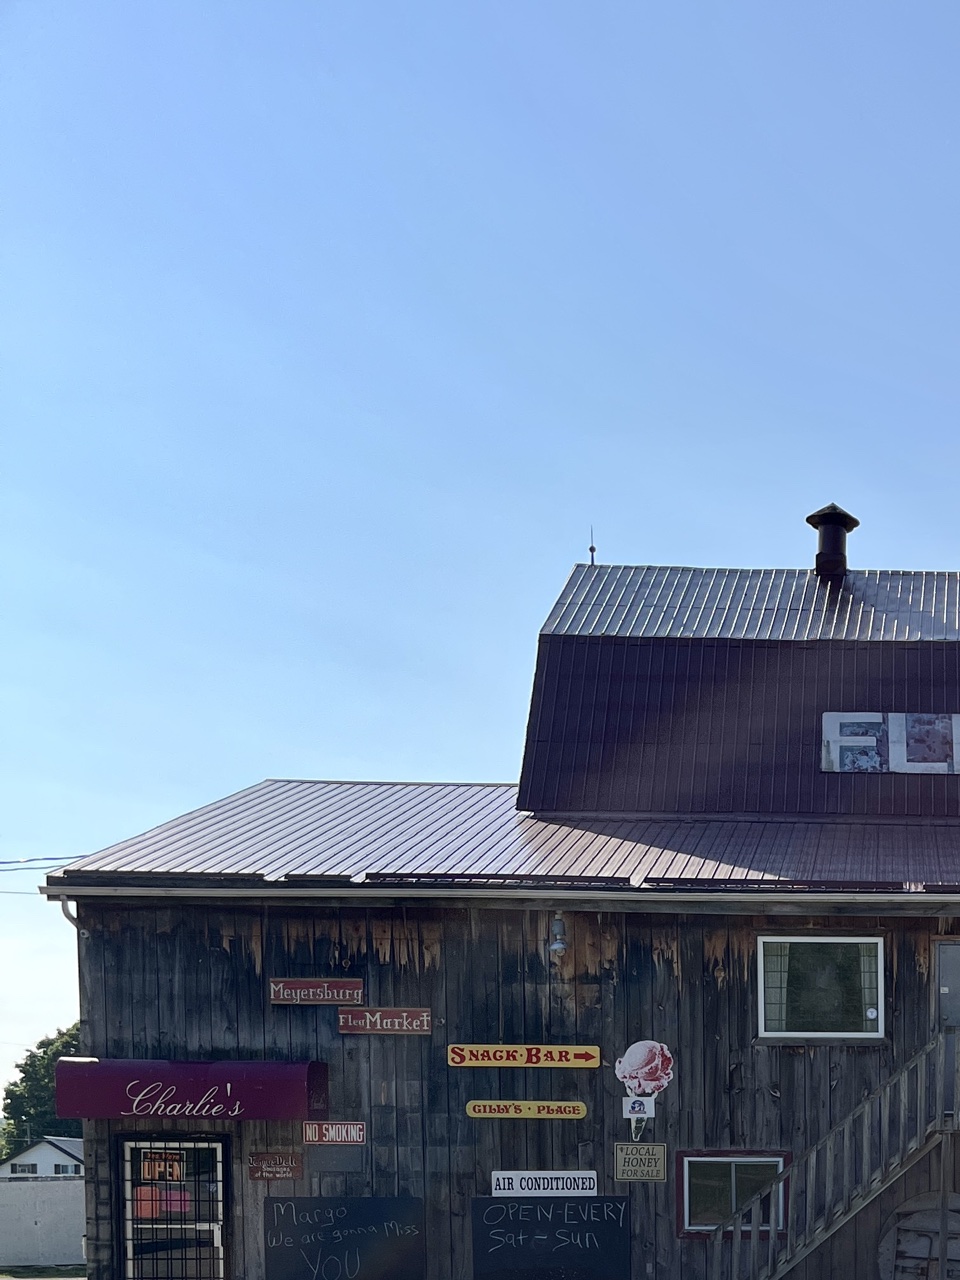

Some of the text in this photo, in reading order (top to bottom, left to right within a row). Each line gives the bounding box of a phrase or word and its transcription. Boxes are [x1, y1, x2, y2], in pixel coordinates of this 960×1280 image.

[269, 982, 363, 1004] Meyersburg
[338, 1011, 431, 1030] Flea Market
[120, 1079, 245, 1117] Charlie's
[472, 1103, 581, 1115] GILLY'S PLACE
[306, 1124, 363, 1142] NO SMOKING
[625, 1147, 656, 1156] LOCAL
[143, 1159, 183, 1181] OPEN
[623, 1158, 660, 1167] HONEY
[621, 1169, 661, 1178] FOR SALE
[494, 1176, 596, 1191] AIR CONDITIONED
[272, 1201, 347, 1228] Margo
[267, 1220, 420, 1248] We are gonna Miss
[487, 1229, 529, 1253] Sat
[552, 1229, 600, 1252] Sun
